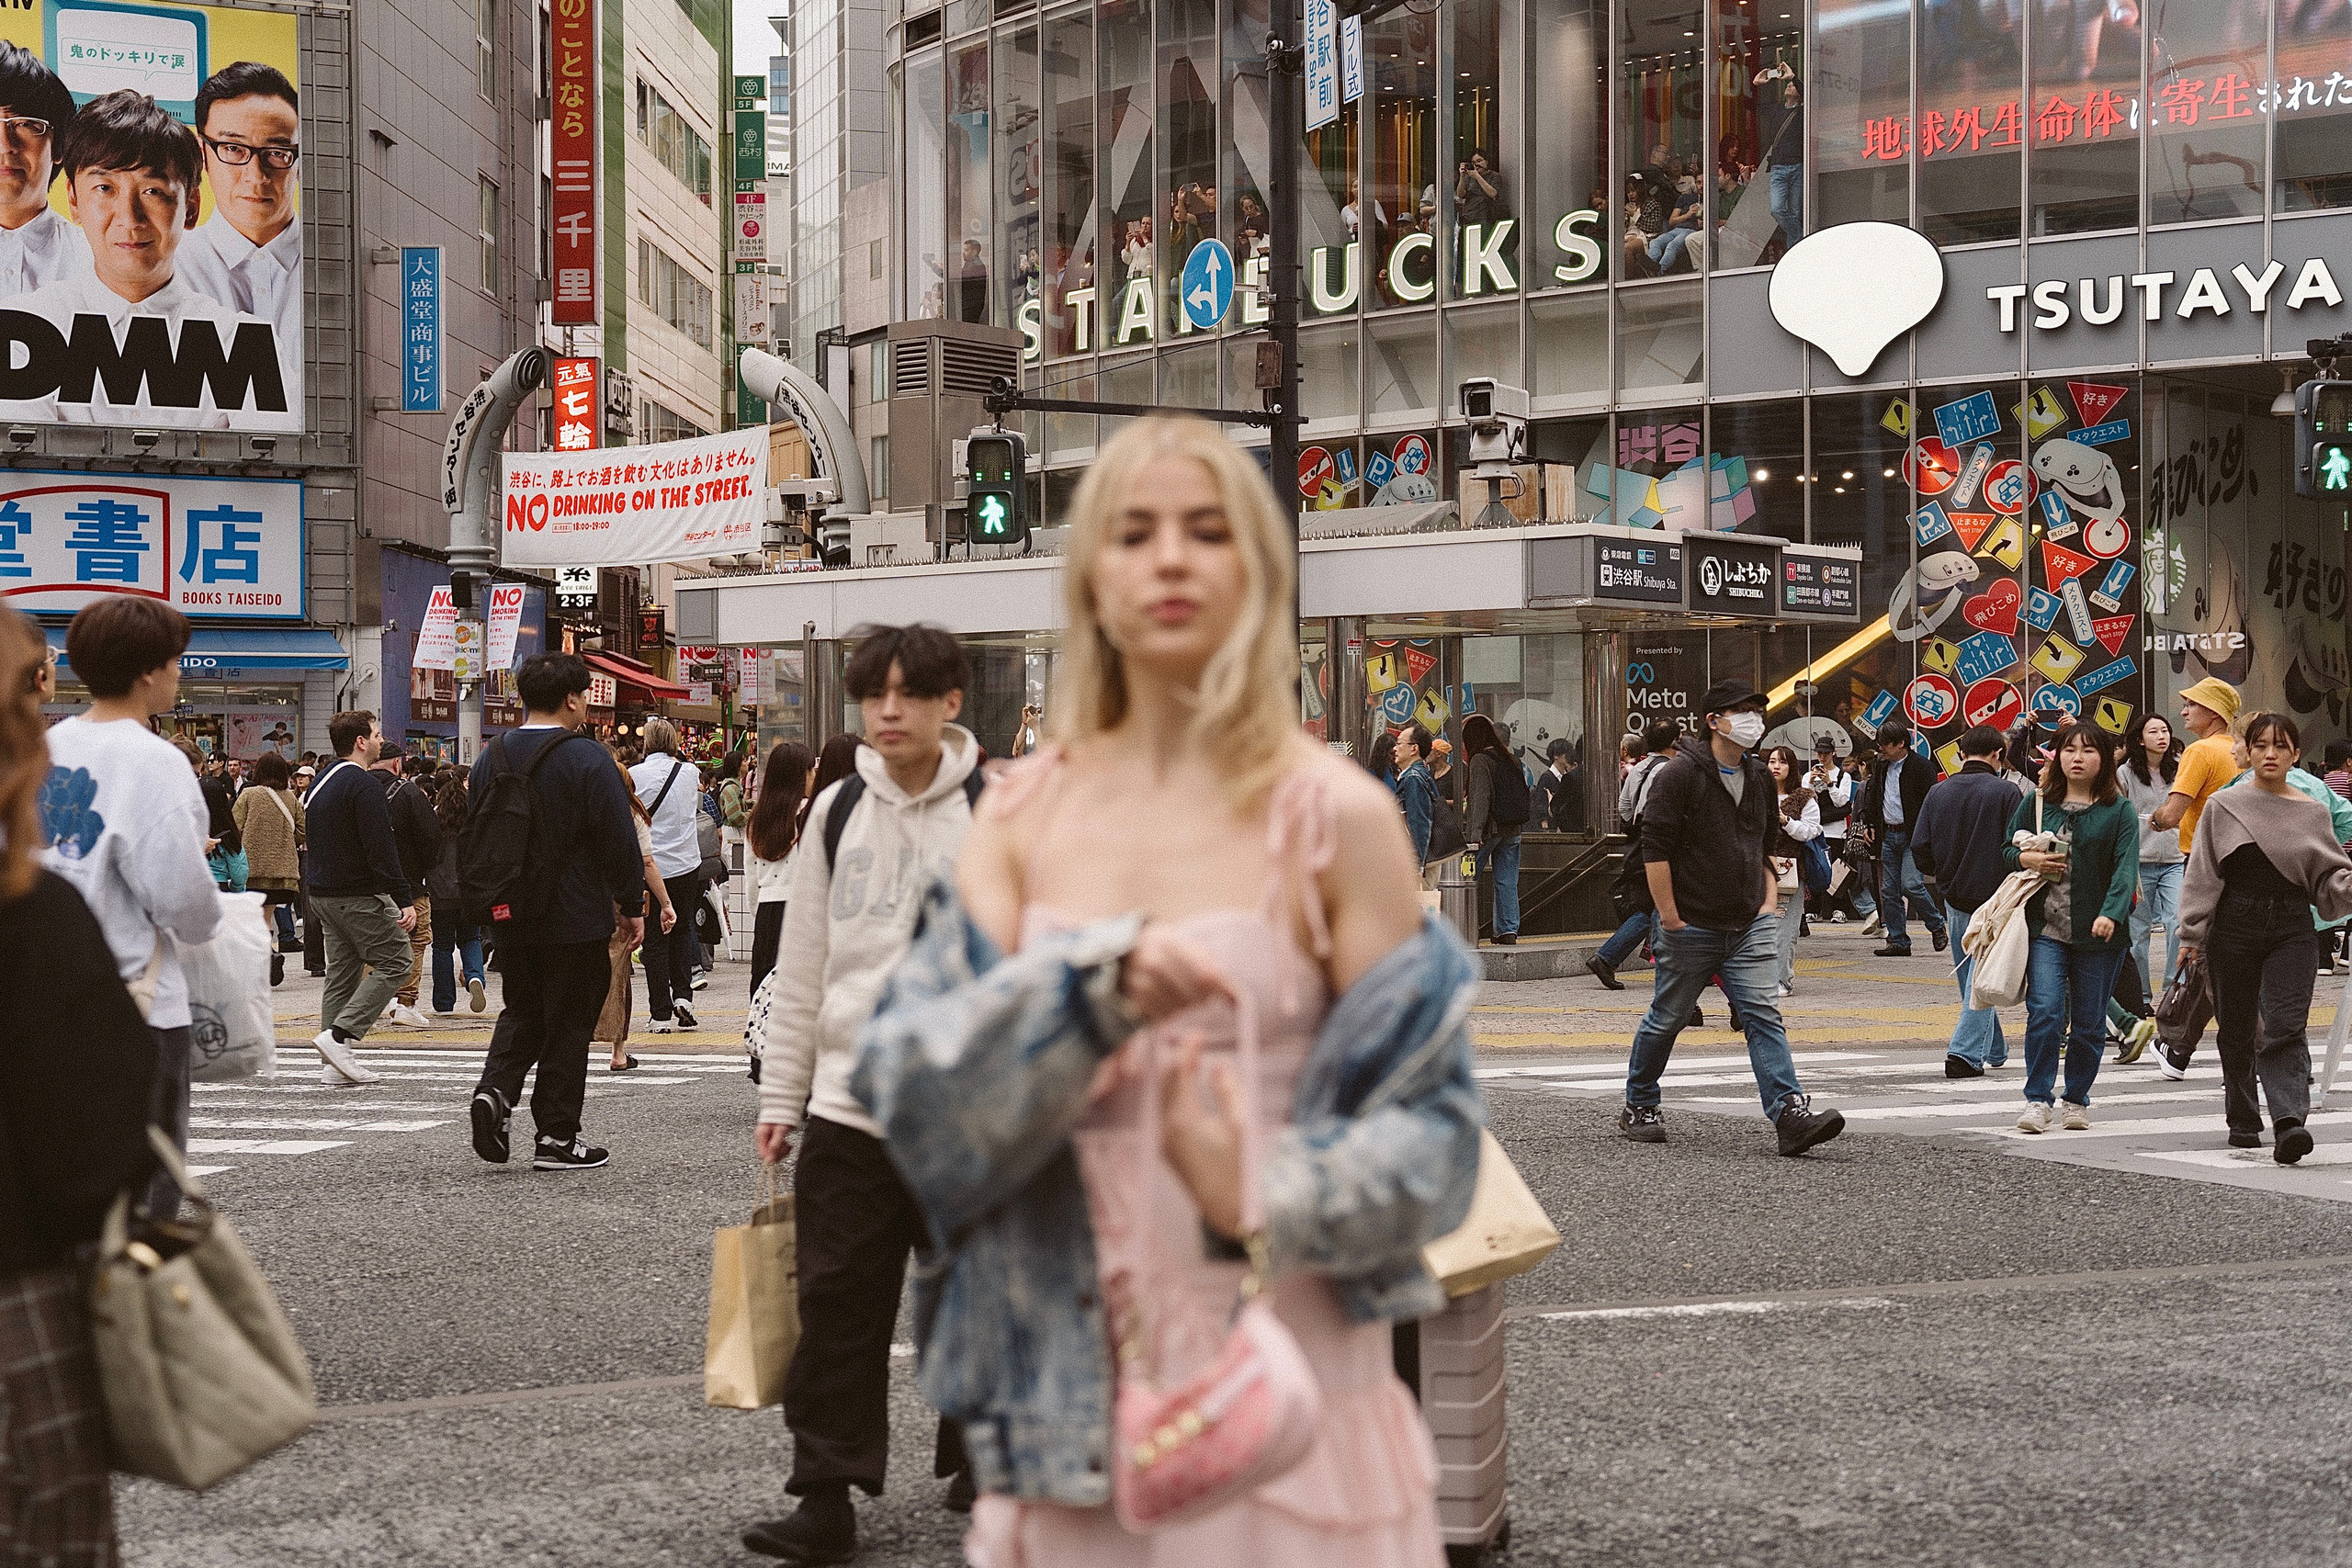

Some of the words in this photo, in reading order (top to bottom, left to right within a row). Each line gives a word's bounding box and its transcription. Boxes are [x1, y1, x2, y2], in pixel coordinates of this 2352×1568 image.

[738, 100, 752, 108] 5F
[556, 160, 593, 302] 三千里
[739, 264, 752, 272] 3F
[1985, 257, 2345, 333] TSUTAYA
[410, 256, 434, 403] 大盛堂商事ビル
[0, 309, 288, 412] DMM
[2082, 391, 2109, 406] 好き
[559, 390, 593, 450] 七輪
[2074, 423, 2124, 443] メタクエスト
[445, 389, 487, 508] 渋谷センター街
[1619, 422, 1701, 467] 渋谷
[1961, 450, 1986, 498] メタクエスト
[507, 493, 548, 532] NO
[552, 491, 626, 517] DRINKING
[632, 489, 655, 511] ON
[661, 485, 689, 509] THE
[694, 475, 752, 506] STREET.
[1956, 517, 1987, 526] 止まるな
[2050, 525, 2076, 539] 飛びこめ
[1724, 559, 1771, 585] しぶちか
[2051, 555, 2077, 572] 好き
[1613, 567, 1643, 587] 渋谷駅
[1644, 575, 1666, 592] Shibuya
[1666, 578, 1678, 590] Sta.
[182, 592, 222, 604] BOOKS
[228, 592, 282, 606] TAISEIDO
[492, 588, 522, 607] NO
[1729, 588, 1764, 599] SHIBUCHIKA
[2092, 593, 2118, 610] 飛びこめ
[491, 607, 519, 615] SMOKING
[1974, 592, 2017, 626] 飛びこめ
[2067, 585, 2087, 636] メタクエスト
[2096, 620, 2127, 633] 止まるな
[1635, 646, 1672, 655] Presented
[1673, 646, 1683, 657] by
[2082, 662, 2128, 690] メタクエスト
[1626, 687, 1687, 709] Meta
